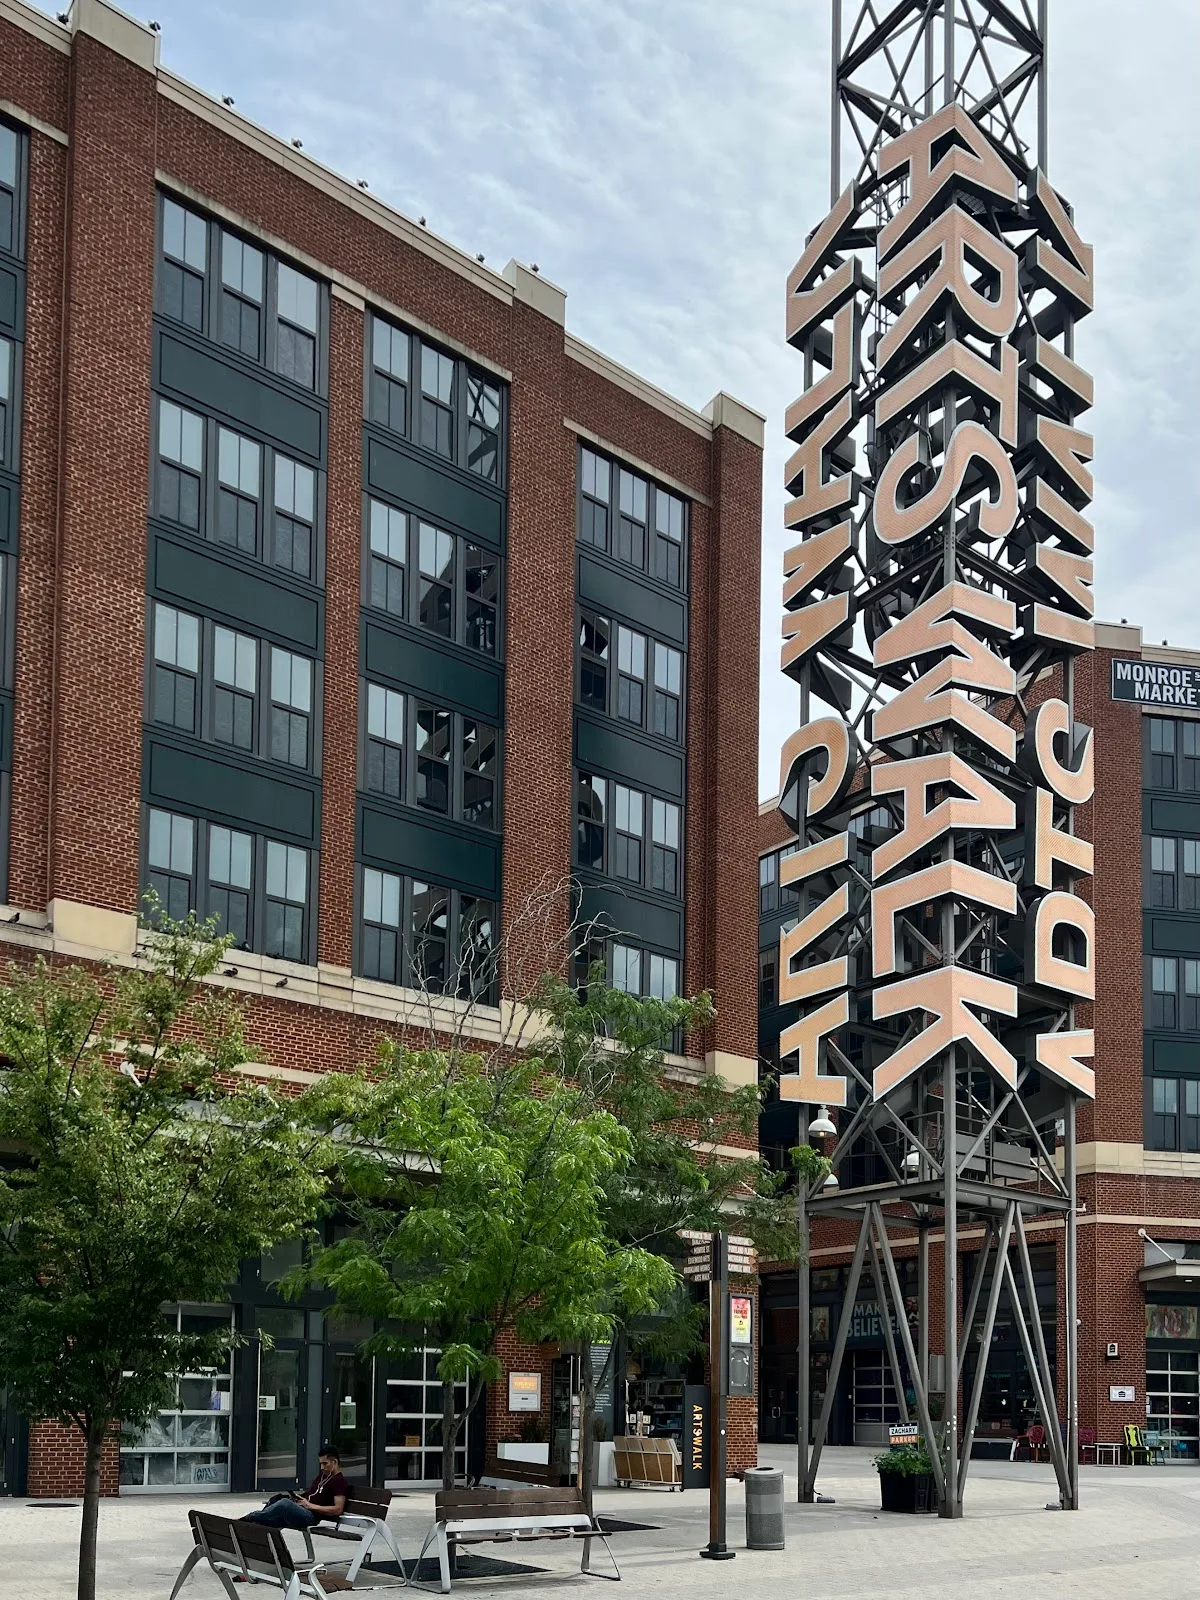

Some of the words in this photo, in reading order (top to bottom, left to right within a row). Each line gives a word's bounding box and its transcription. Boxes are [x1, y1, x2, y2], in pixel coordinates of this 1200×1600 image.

[873, 102, 1019, 545] ARTS
[1116, 662, 1192, 687] MONROE
[1194, 671, 1200, 681] S
[1134, 682, 1200, 705] MARKE
[870, 580, 1019, 1102] WALK
[853, 1302, 888, 1317] MAK
[891, 1436, 916, 1444] PARKER
